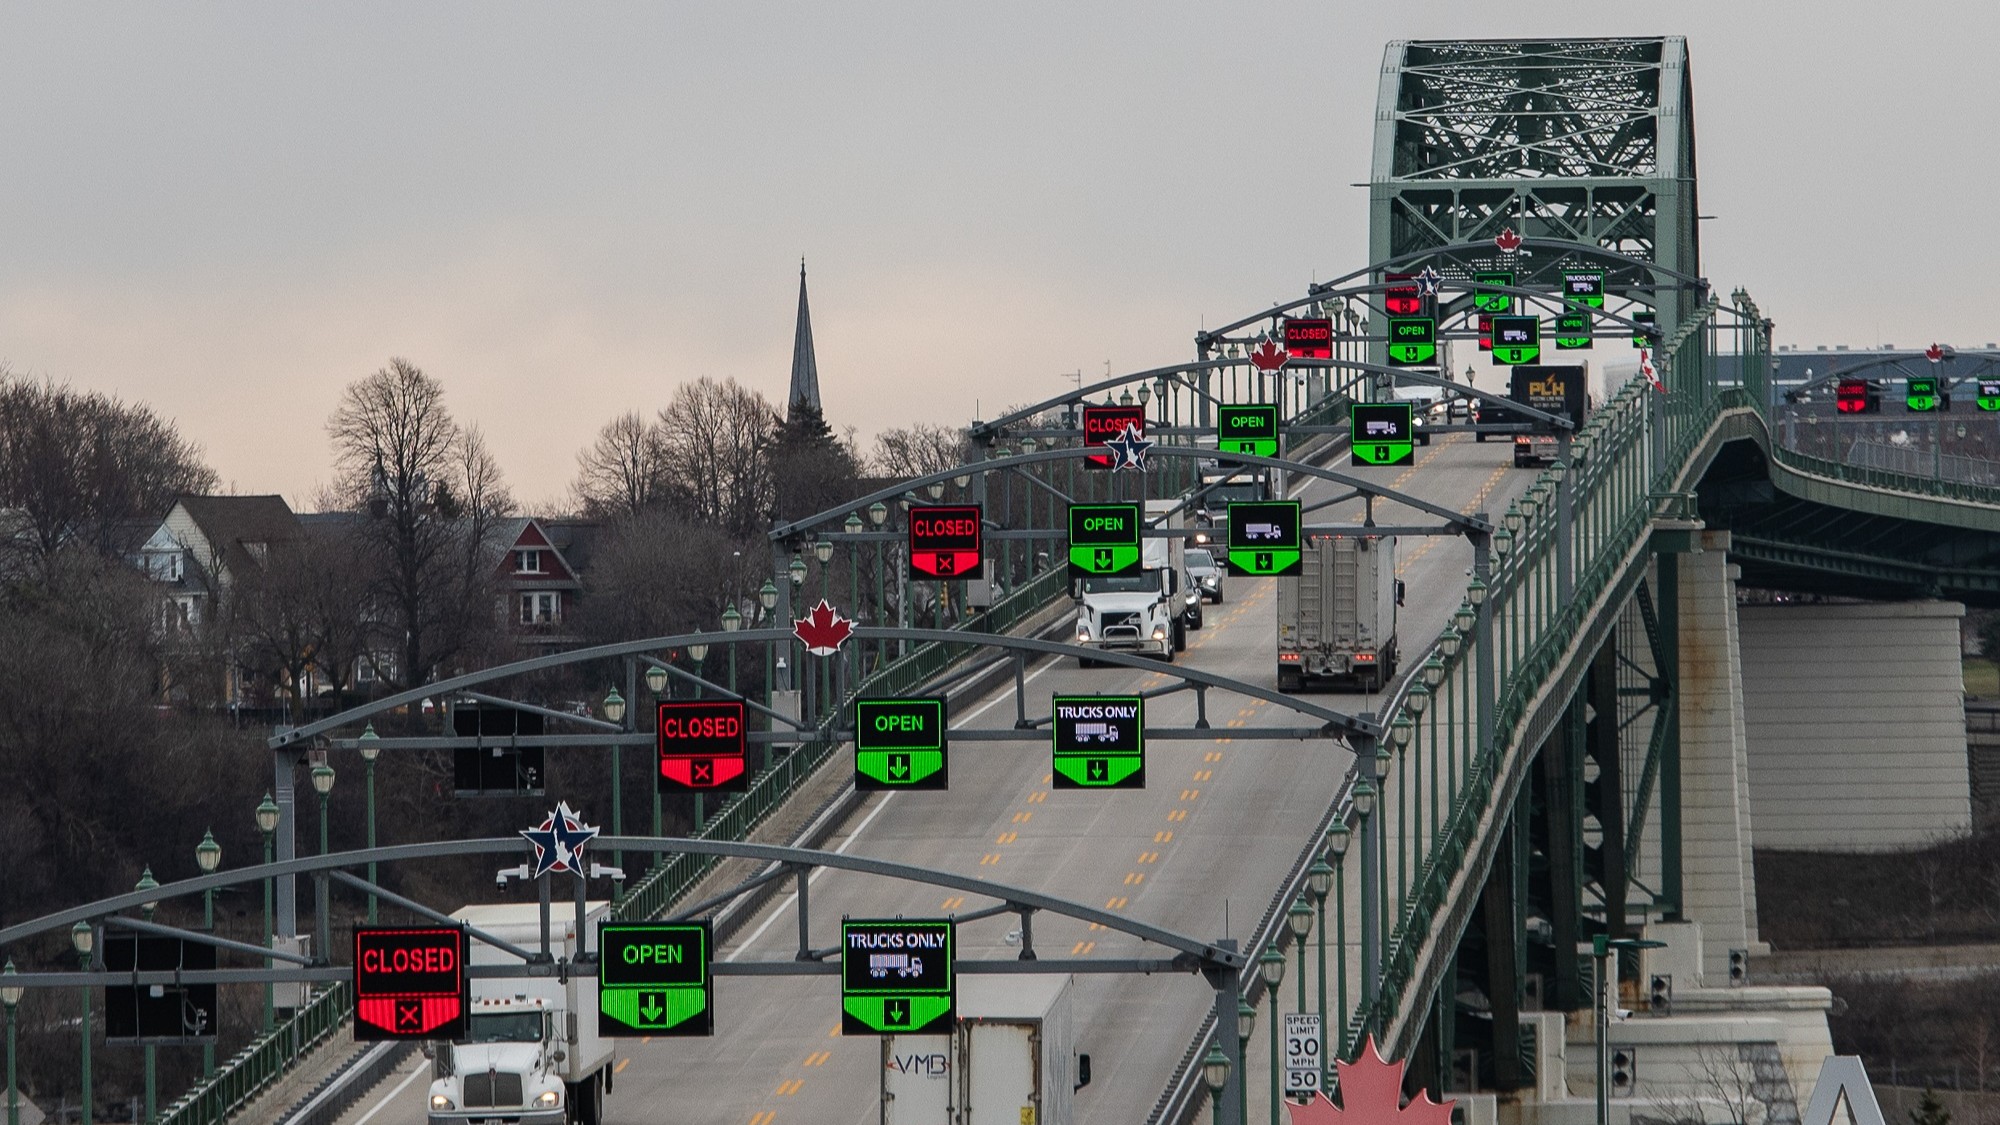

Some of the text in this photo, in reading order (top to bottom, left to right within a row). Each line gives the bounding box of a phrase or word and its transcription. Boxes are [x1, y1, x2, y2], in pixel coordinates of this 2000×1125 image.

[1289, 329, 1327, 339] CLOSED
[1399, 326, 1425, 335] OPEN
[1529, 382, 1564, 396] PLH
[1912, 383, 1930, 391] OPEN
[1089, 417, 1139, 433] CLOSED
[1231, 416, 1265, 428] OPEN
[915, 520, 975, 537] CLOSED
[1084, 517, 1123, 531] OPEN
[1057, 706, 1137, 719] TRUCKS ONLY
[664, 717, 739, 738] CLOSED
[875, 715, 923, 731] OPEN
[847, 932, 946, 949] TRUCKS ONLY
[363, 947, 454, 973] CLOSED
[623, 944, 683, 964] OPEN
[1287, 1016, 1319, 1025] SPEED
[1290, 1026, 1316, 1035] LIMIT
[1288, 1038, 1319, 1056] 30
[895, 1054, 947, 1075] VMB
[1292, 1058, 1315, 1066] MPH
[1291, 1071, 1316, 1087] 50
